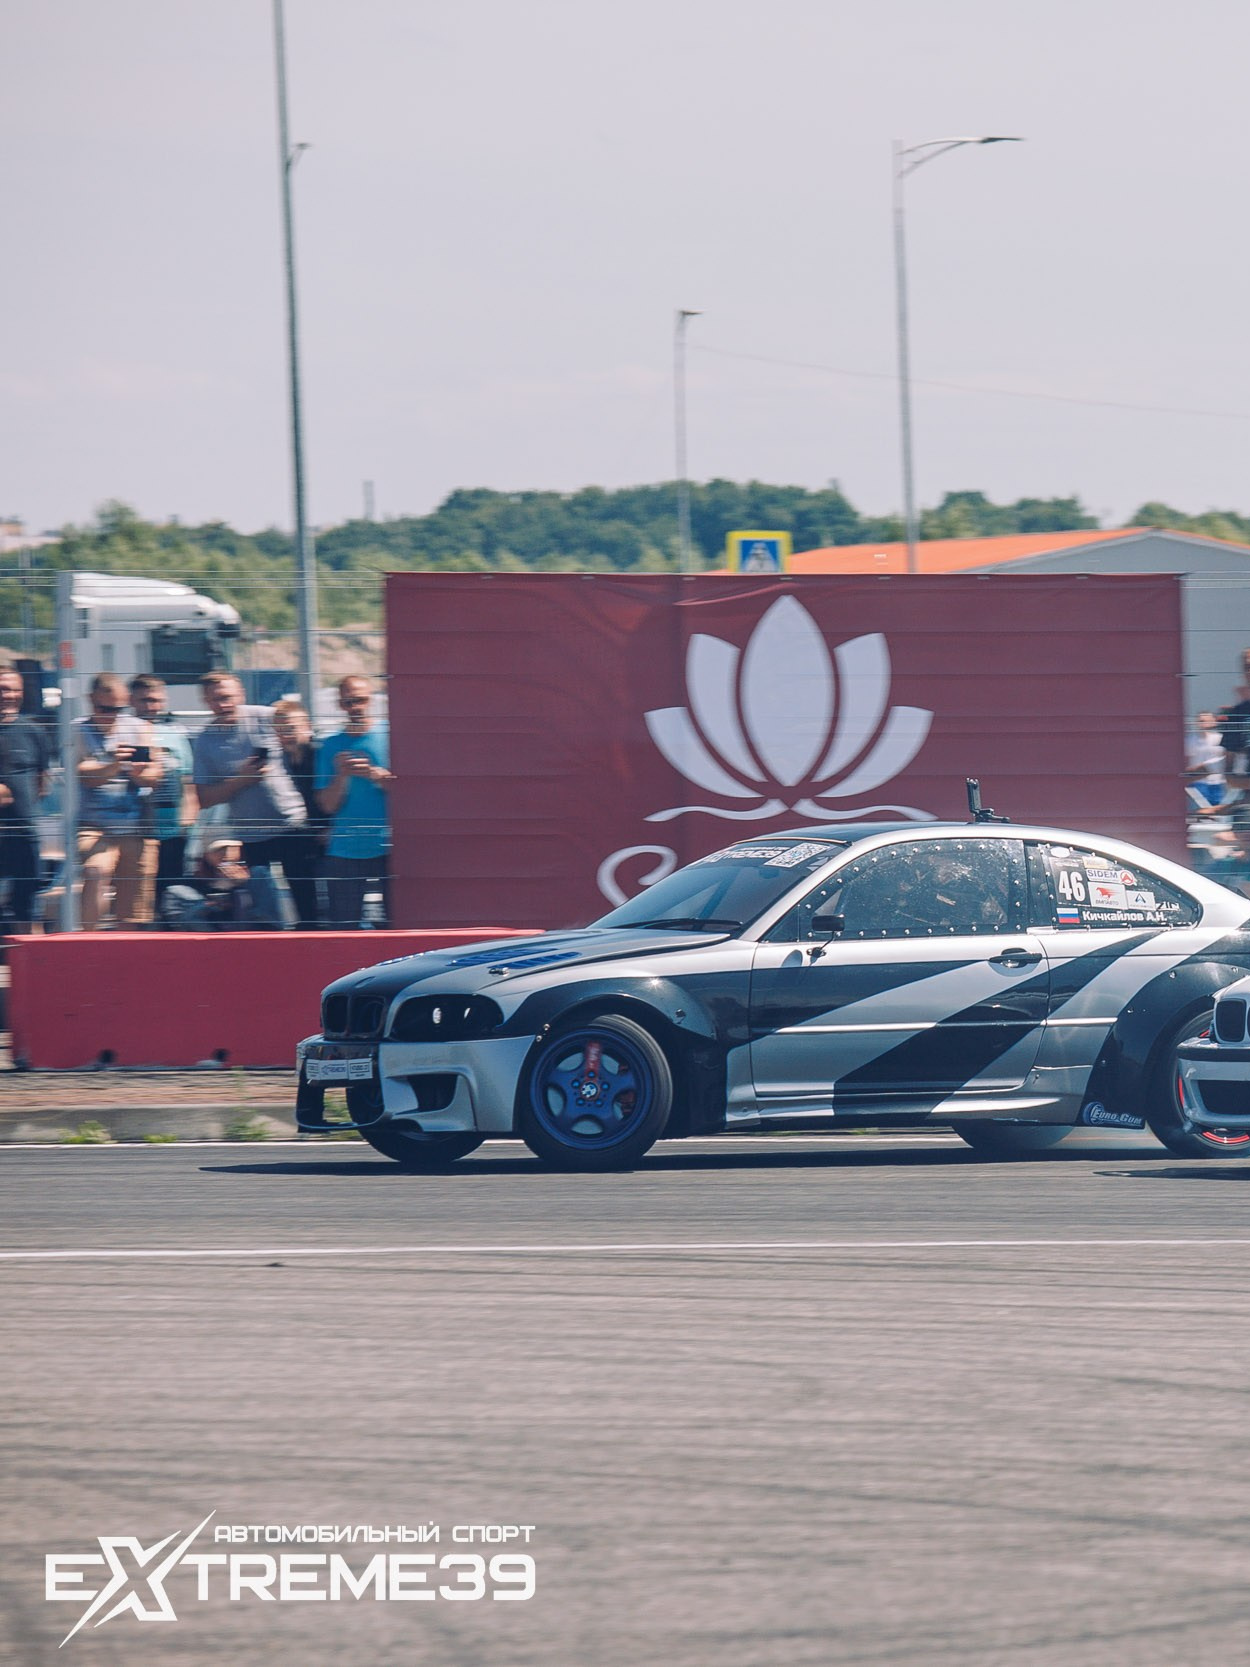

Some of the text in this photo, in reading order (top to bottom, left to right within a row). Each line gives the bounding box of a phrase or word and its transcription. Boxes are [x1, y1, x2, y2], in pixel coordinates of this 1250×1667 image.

[1087, 869, 1118, 879] SIDEM
[1058, 871, 1086, 902] 46
[1082, 910, 1168, 922] Кичкайлов А.Н.
